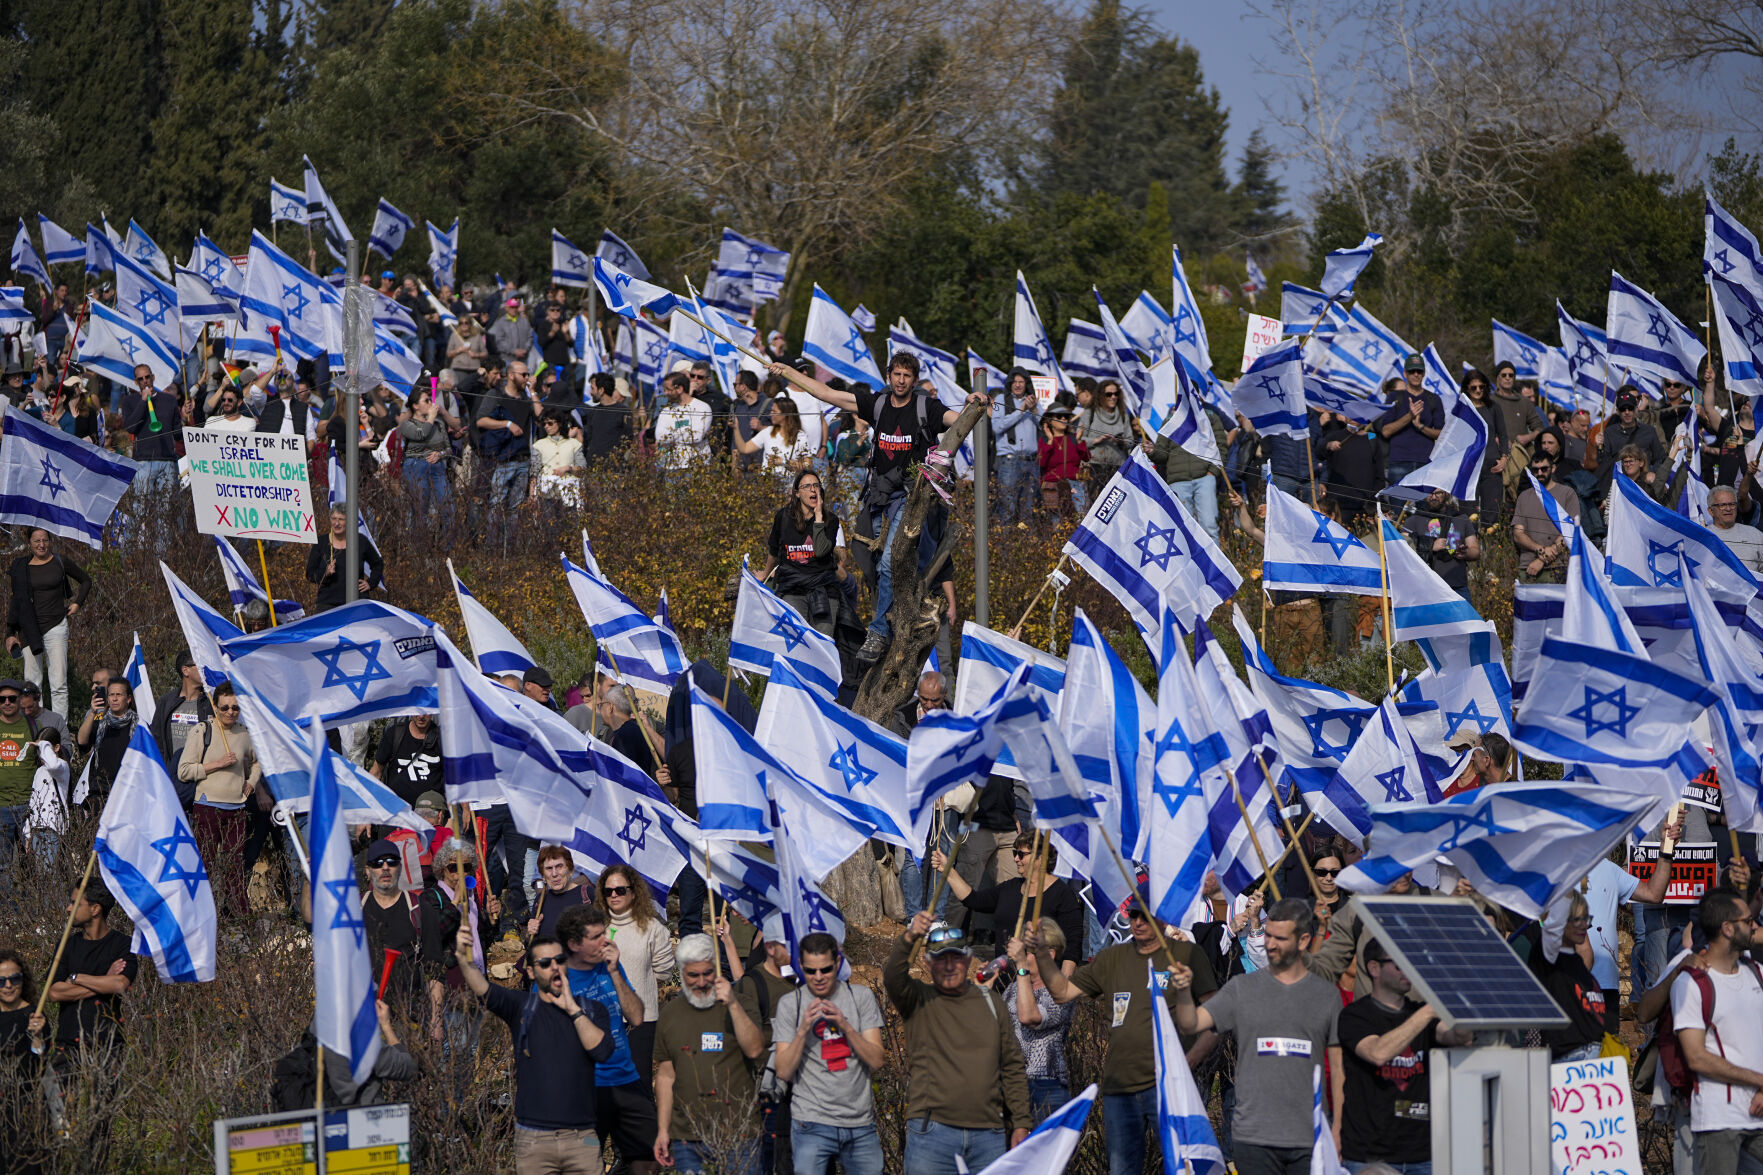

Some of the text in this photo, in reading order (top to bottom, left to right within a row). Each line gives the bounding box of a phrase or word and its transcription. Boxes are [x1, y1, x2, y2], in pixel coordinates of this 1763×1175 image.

[187, 432, 299, 450] DONT CRY FOR ME
[880, 431, 912, 443] מושחתם
[219, 446, 265, 461] ISRAEL
[190, 459, 307, 482] WE SHALL OVER COME
[233, 506, 259, 529] NO
[264, 508, 302, 532] WAY
[1565, 1060, 1614, 1084] מהות
[1580, 1117, 1627, 1140] אינה
